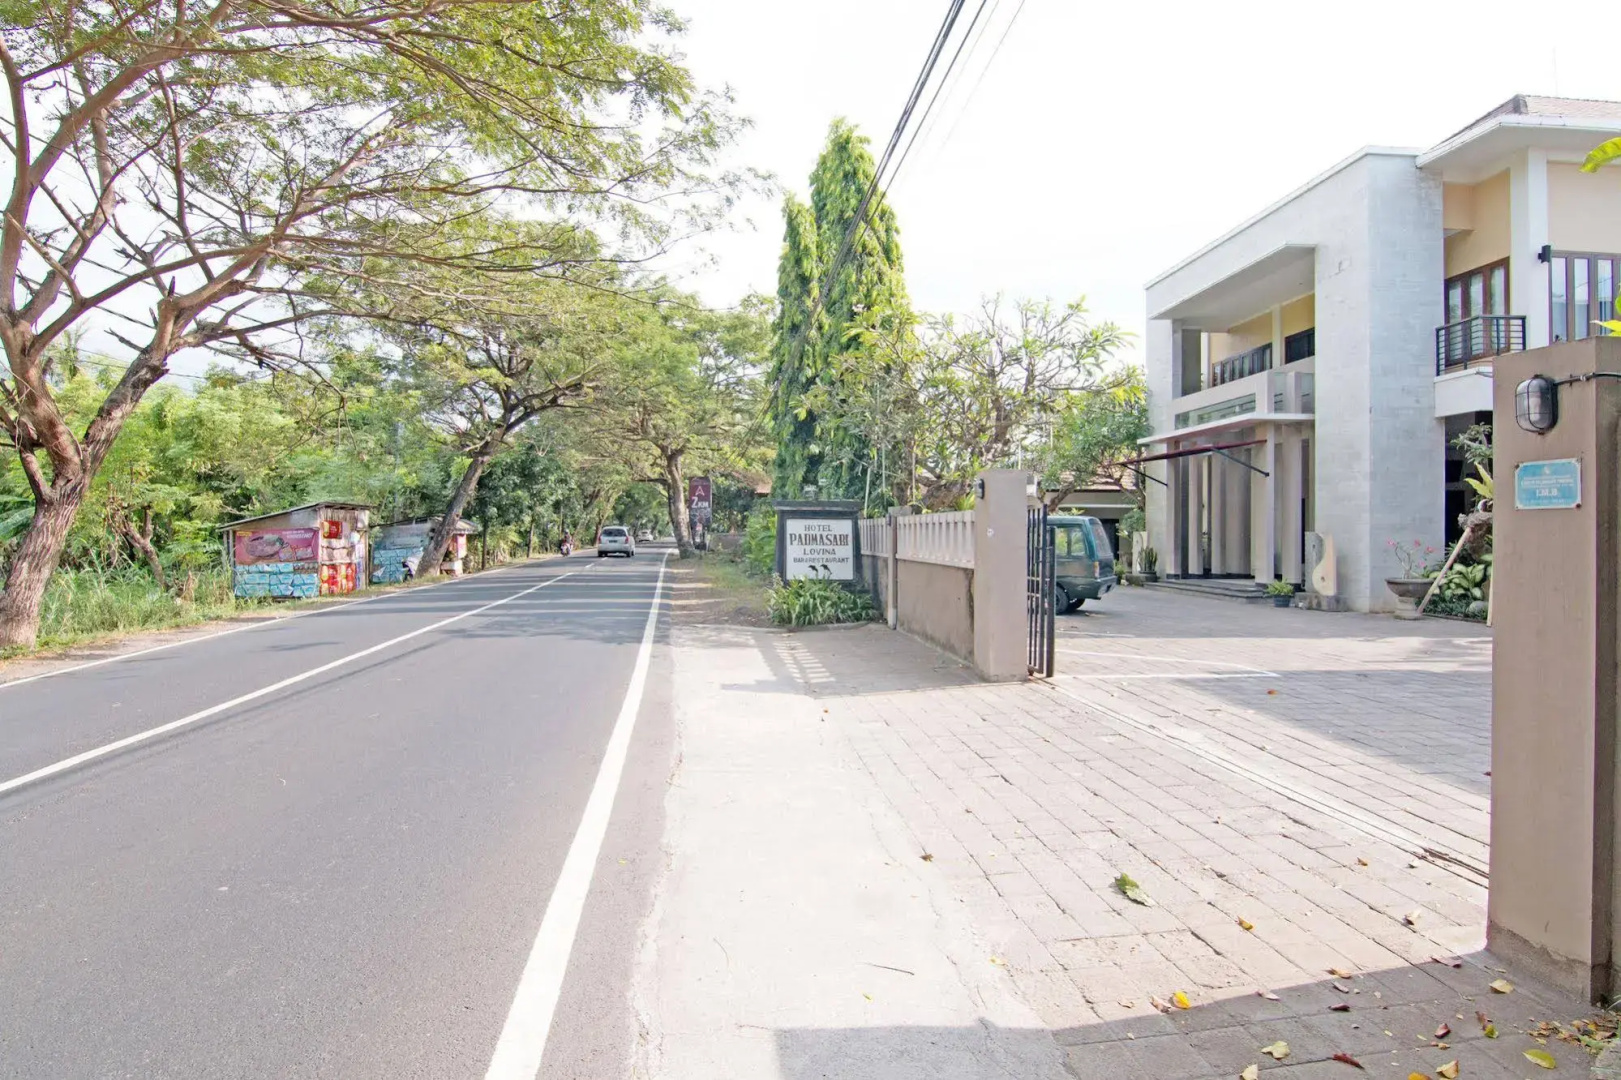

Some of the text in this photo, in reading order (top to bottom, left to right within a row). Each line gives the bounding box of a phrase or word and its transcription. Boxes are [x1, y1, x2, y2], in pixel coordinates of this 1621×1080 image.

[804, 524, 832, 532] HOTEL
[789, 533, 850, 546] PADMASARI
[803, 548, 837, 556] LOVINA
